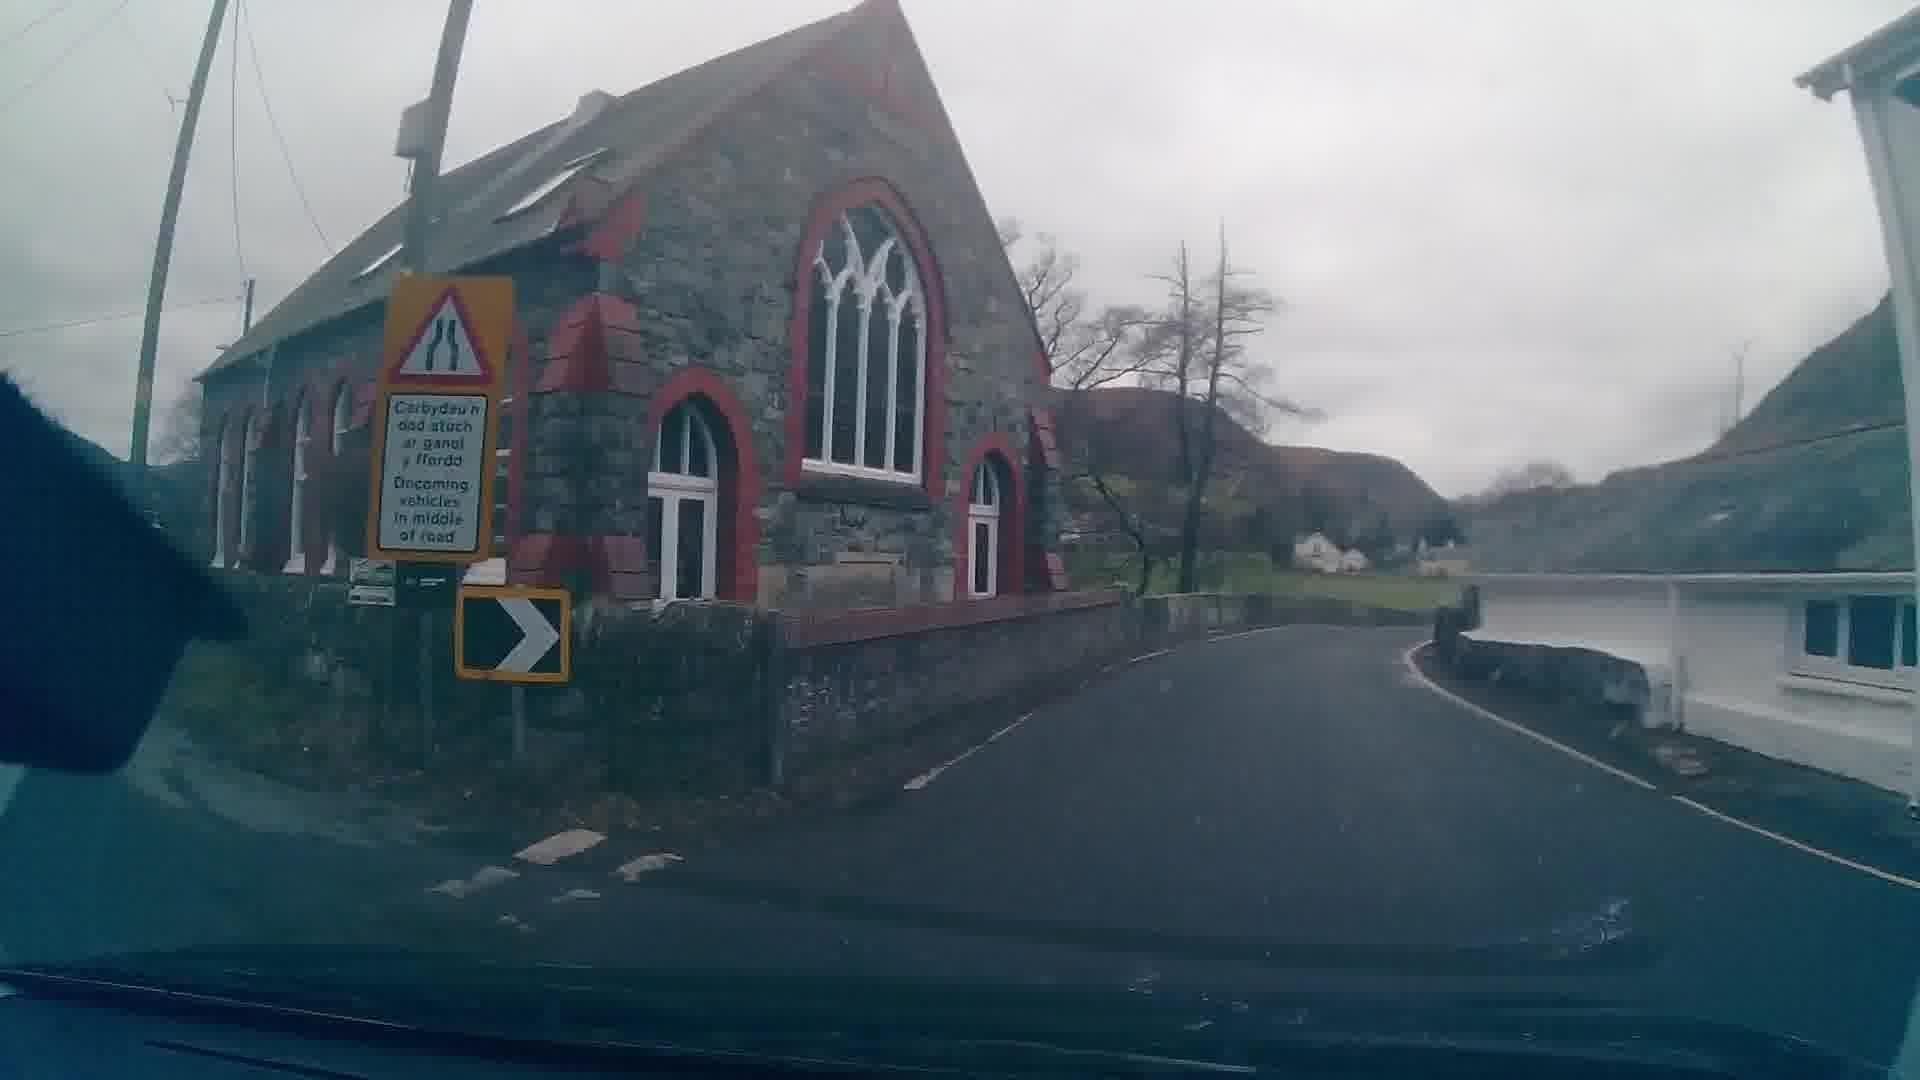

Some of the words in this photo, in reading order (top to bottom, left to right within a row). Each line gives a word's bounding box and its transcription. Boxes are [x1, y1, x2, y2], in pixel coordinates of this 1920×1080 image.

[394, 401, 480, 417] Cerbydaun
[394, 476, 469, 493] Oncoming
[401, 495, 459, 507] vehicles
[394, 511, 407, 524] in
[413, 511, 464, 525] middle
[400, 530, 415, 542] of
[422, 530, 455, 543] road
